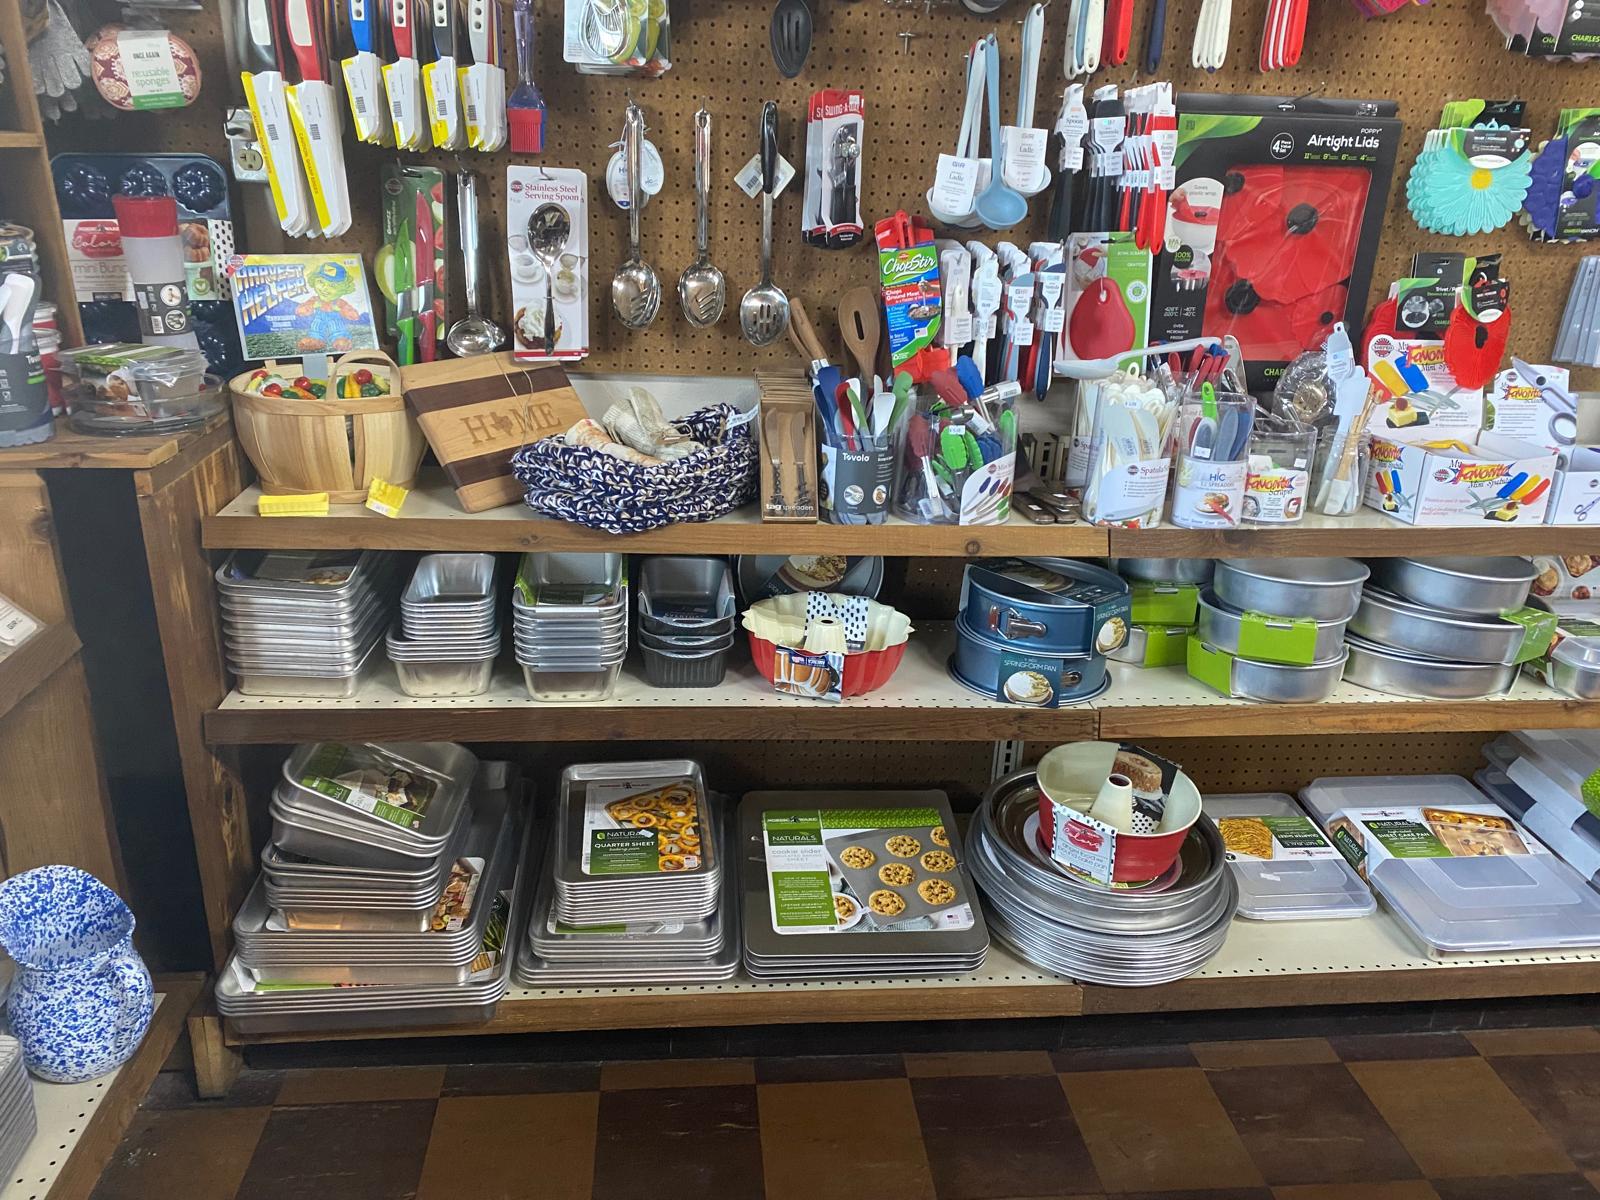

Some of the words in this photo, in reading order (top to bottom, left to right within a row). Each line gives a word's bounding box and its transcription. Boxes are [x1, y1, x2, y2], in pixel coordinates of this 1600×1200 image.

[131, 66, 170, 78] reusable
[135, 77, 170, 88] sponges
[1272, 140, 1280, 153] 4
[1307, 134, 1354, 152] Airtight
[1355, 135, 1380, 148] Lids
[525, 183, 559, 193] Stainless
[559, 184, 578, 193] Steel
[525, 191, 554, 201] Serving
[555, 192, 579, 203] Spoon
[884, 253, 936, 275] ChopStir
[235, 264, 305, 294] HARVEST
[238, 277, 310, 327] HELPER
[842, 452, 870, 462] Tovolo
[1140, 466, 1163, 476] Spatula
[1452, 463, 1509, 485] Favorite
[1245, 472, 1291, 492] Favorite
[766, 503, 782, 511] tag
[1003, 659, 1044, 670] SPRINGFORM
[1043, 664, 1057, 672] PAN
